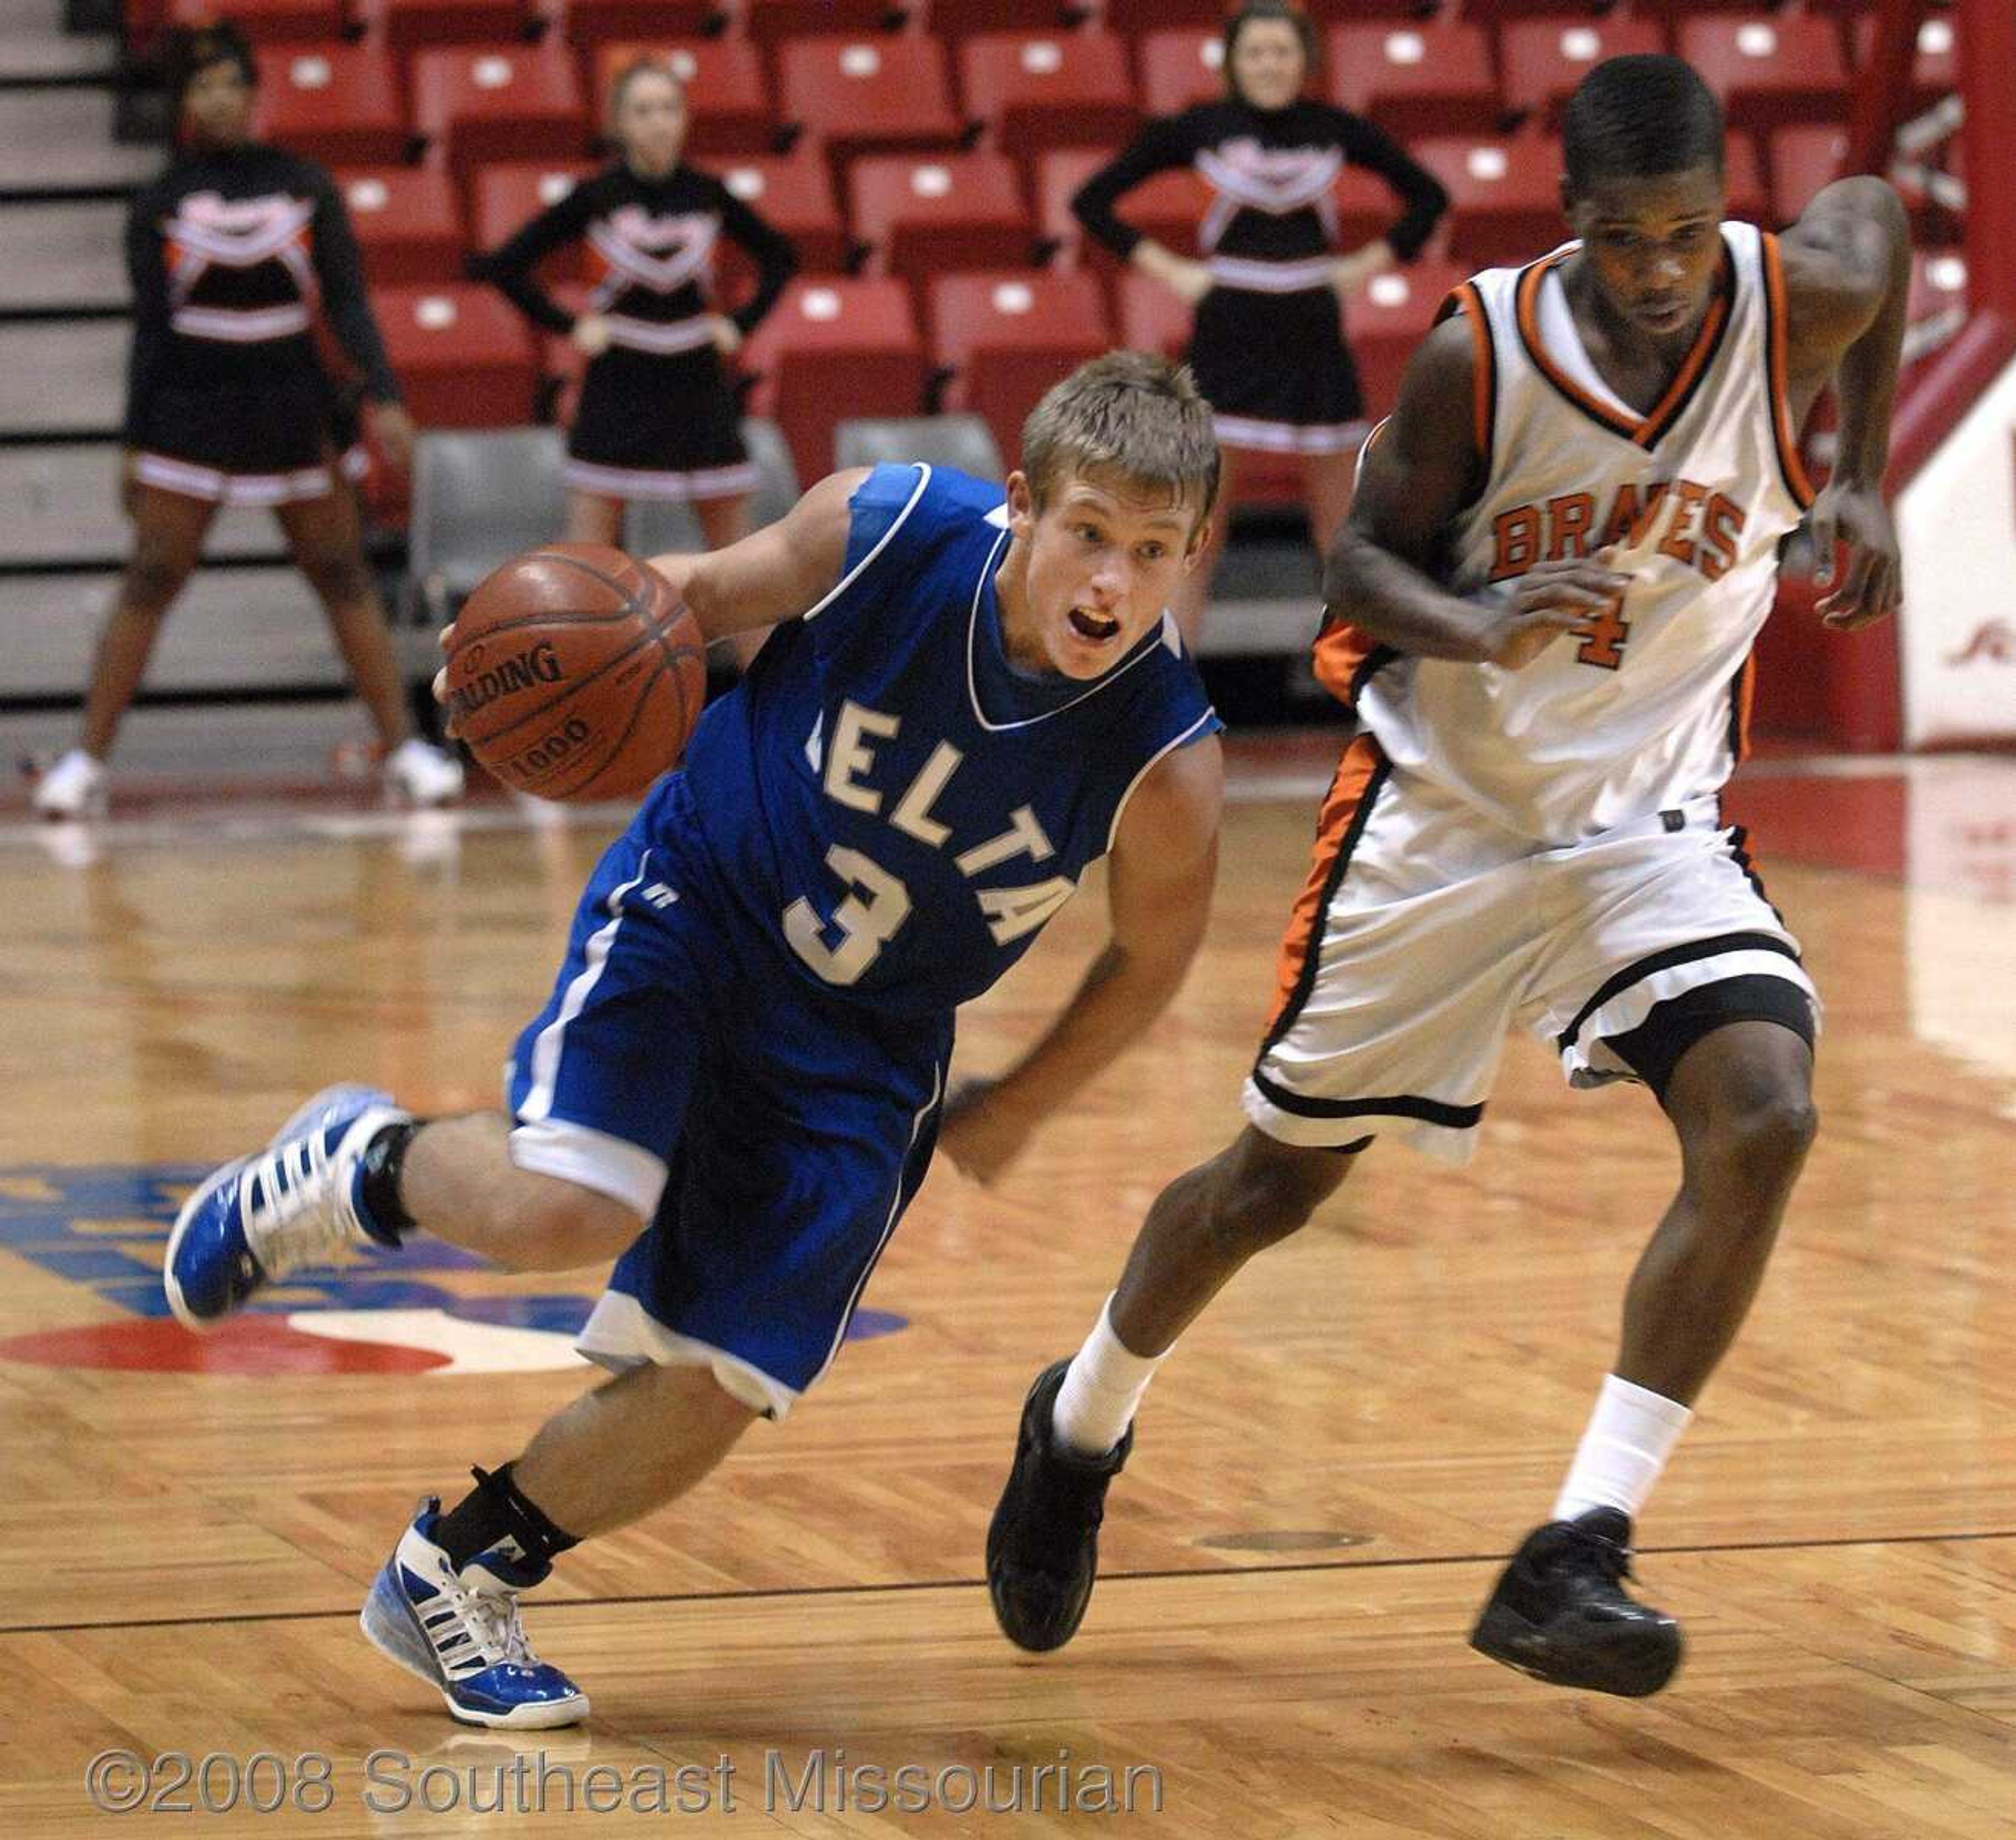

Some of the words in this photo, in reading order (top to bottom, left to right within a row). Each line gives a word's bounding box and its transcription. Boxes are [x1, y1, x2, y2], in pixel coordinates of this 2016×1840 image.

[1490, 479, 1746, 583] BRAVES
[1570, 589, 1629, 671] 4
[805, 698, 1077, 947] ELTA
[782, 843, 913, 986] 3
